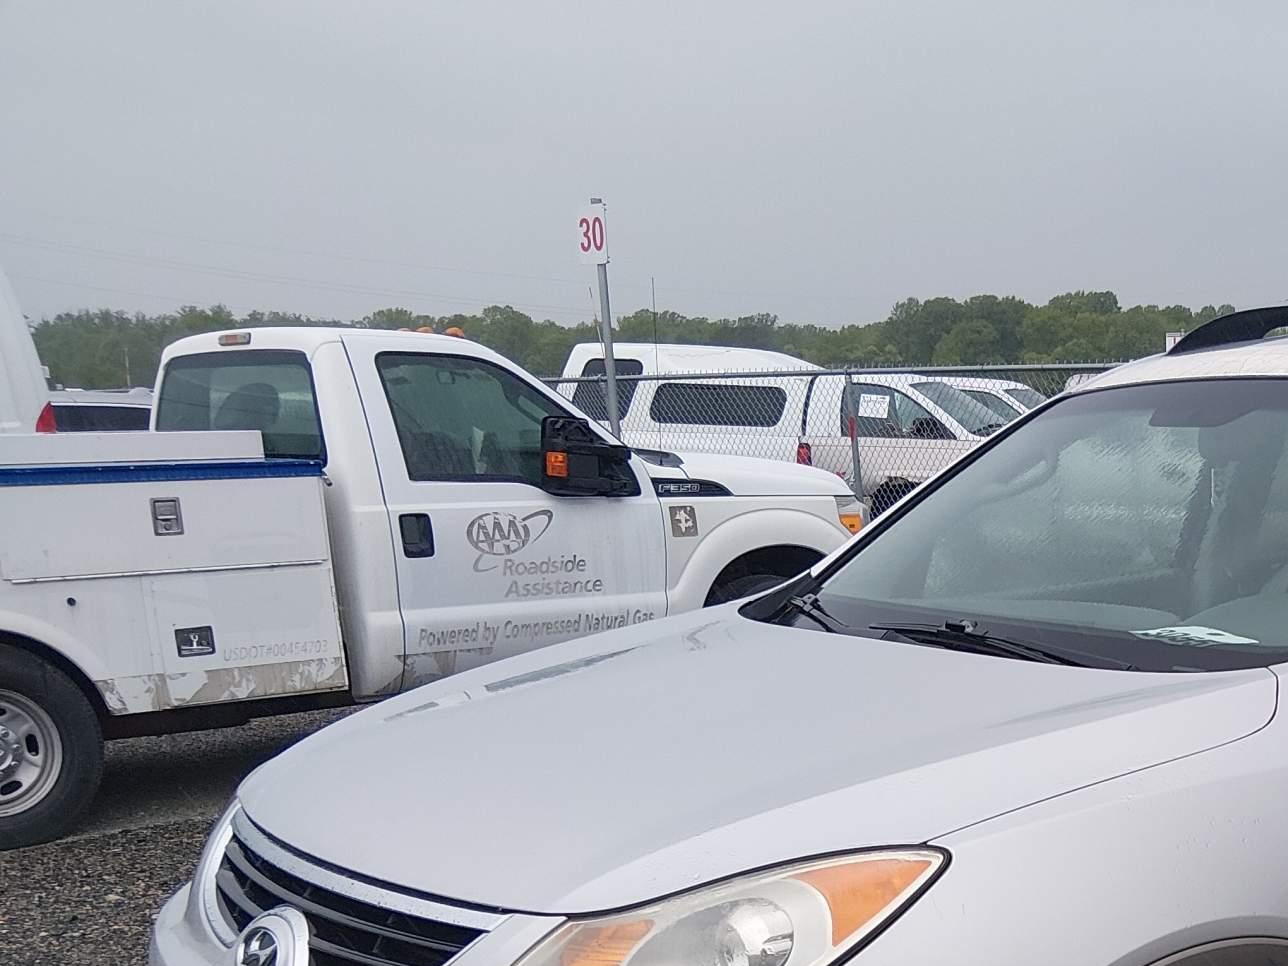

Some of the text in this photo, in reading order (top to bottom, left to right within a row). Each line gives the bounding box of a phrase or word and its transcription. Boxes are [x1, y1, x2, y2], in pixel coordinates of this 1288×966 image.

[579, 216, 604, 252] 30
[658, 483, 700, 493] F350
[471, 513, 526, 551] AAA
[502, 554, 586, 577] Roadside
[504, 577, 603, 598] Assistance
[418, 621, 479, 648] Powered
[482, 620, 500, 645] by
[504, 612, 581, 641] Compressed
[585, 608, 630, 632] Natural
